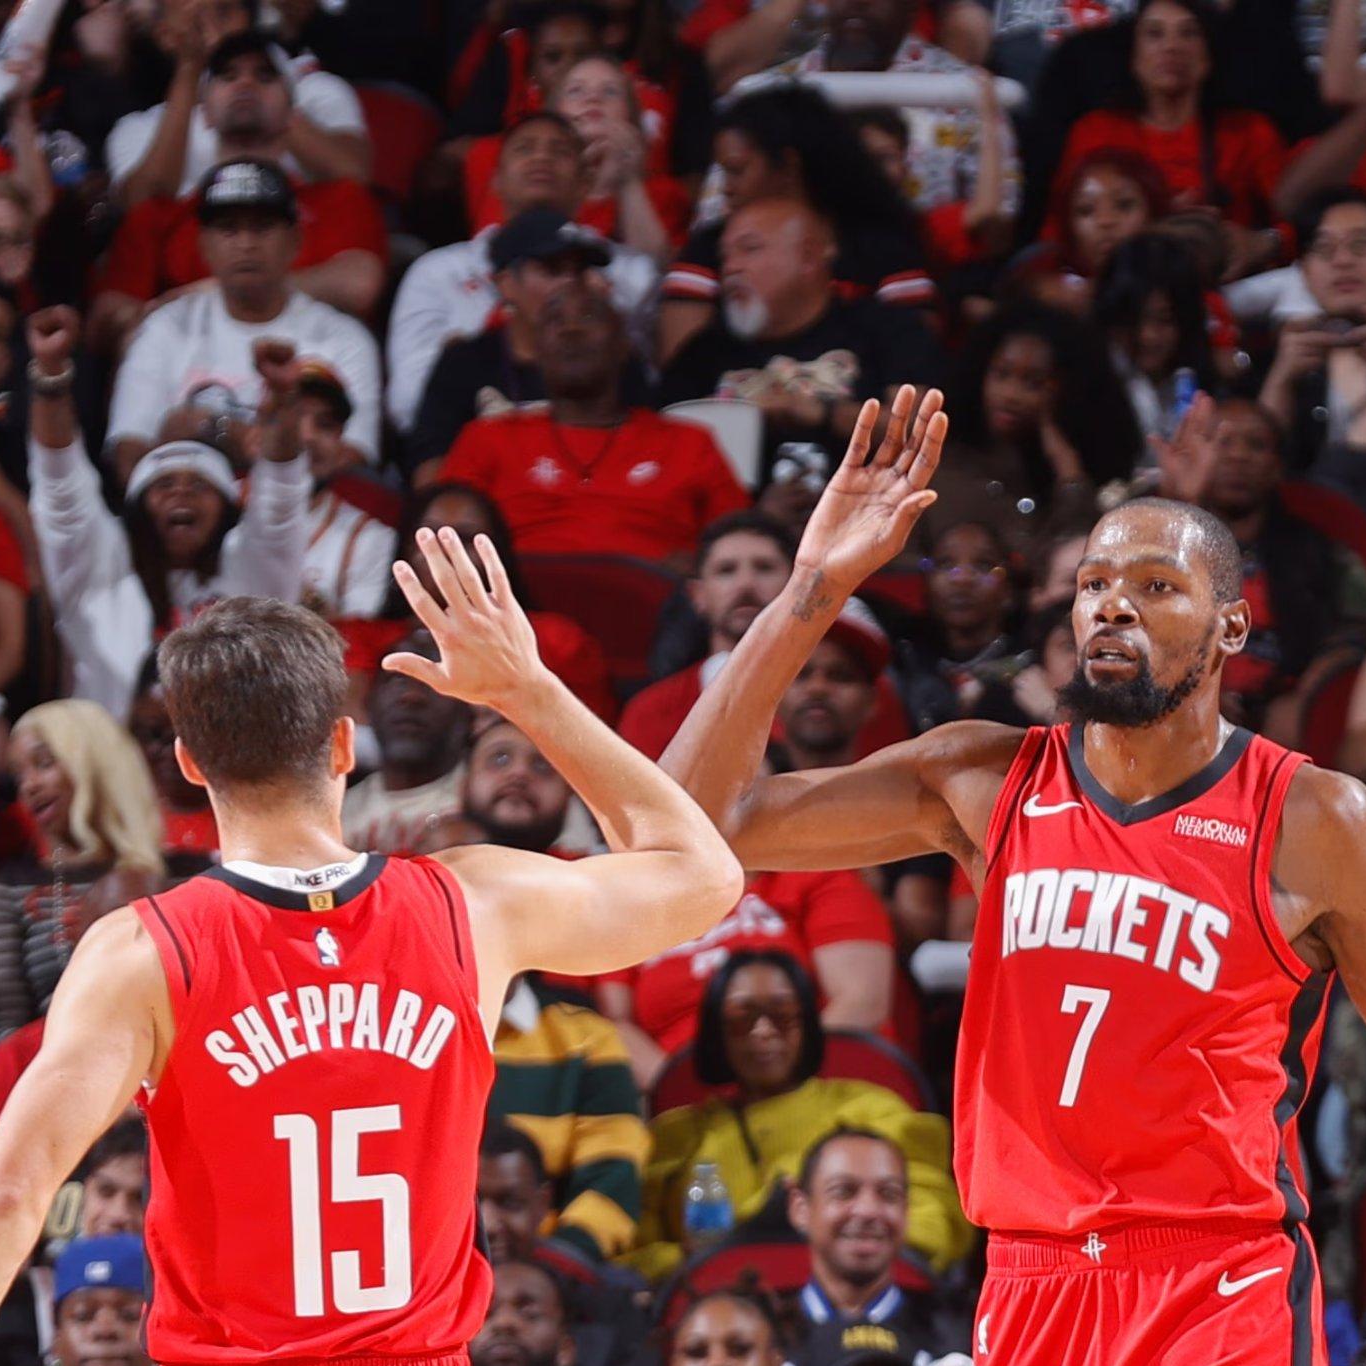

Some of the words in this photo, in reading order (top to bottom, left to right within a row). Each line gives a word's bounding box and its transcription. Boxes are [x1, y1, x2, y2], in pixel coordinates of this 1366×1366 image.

[1173, 824, 1248, 847] HERMANN
[1174, 814, 1247, 838] MEMORIAL
[1001, 867, 1232, 994] ROCKETS
[203, 981, 457, 1088] SHEPPARD
[1059, 983, 1112, 1108] 7
[273, 1103, 412, 1318] 15
